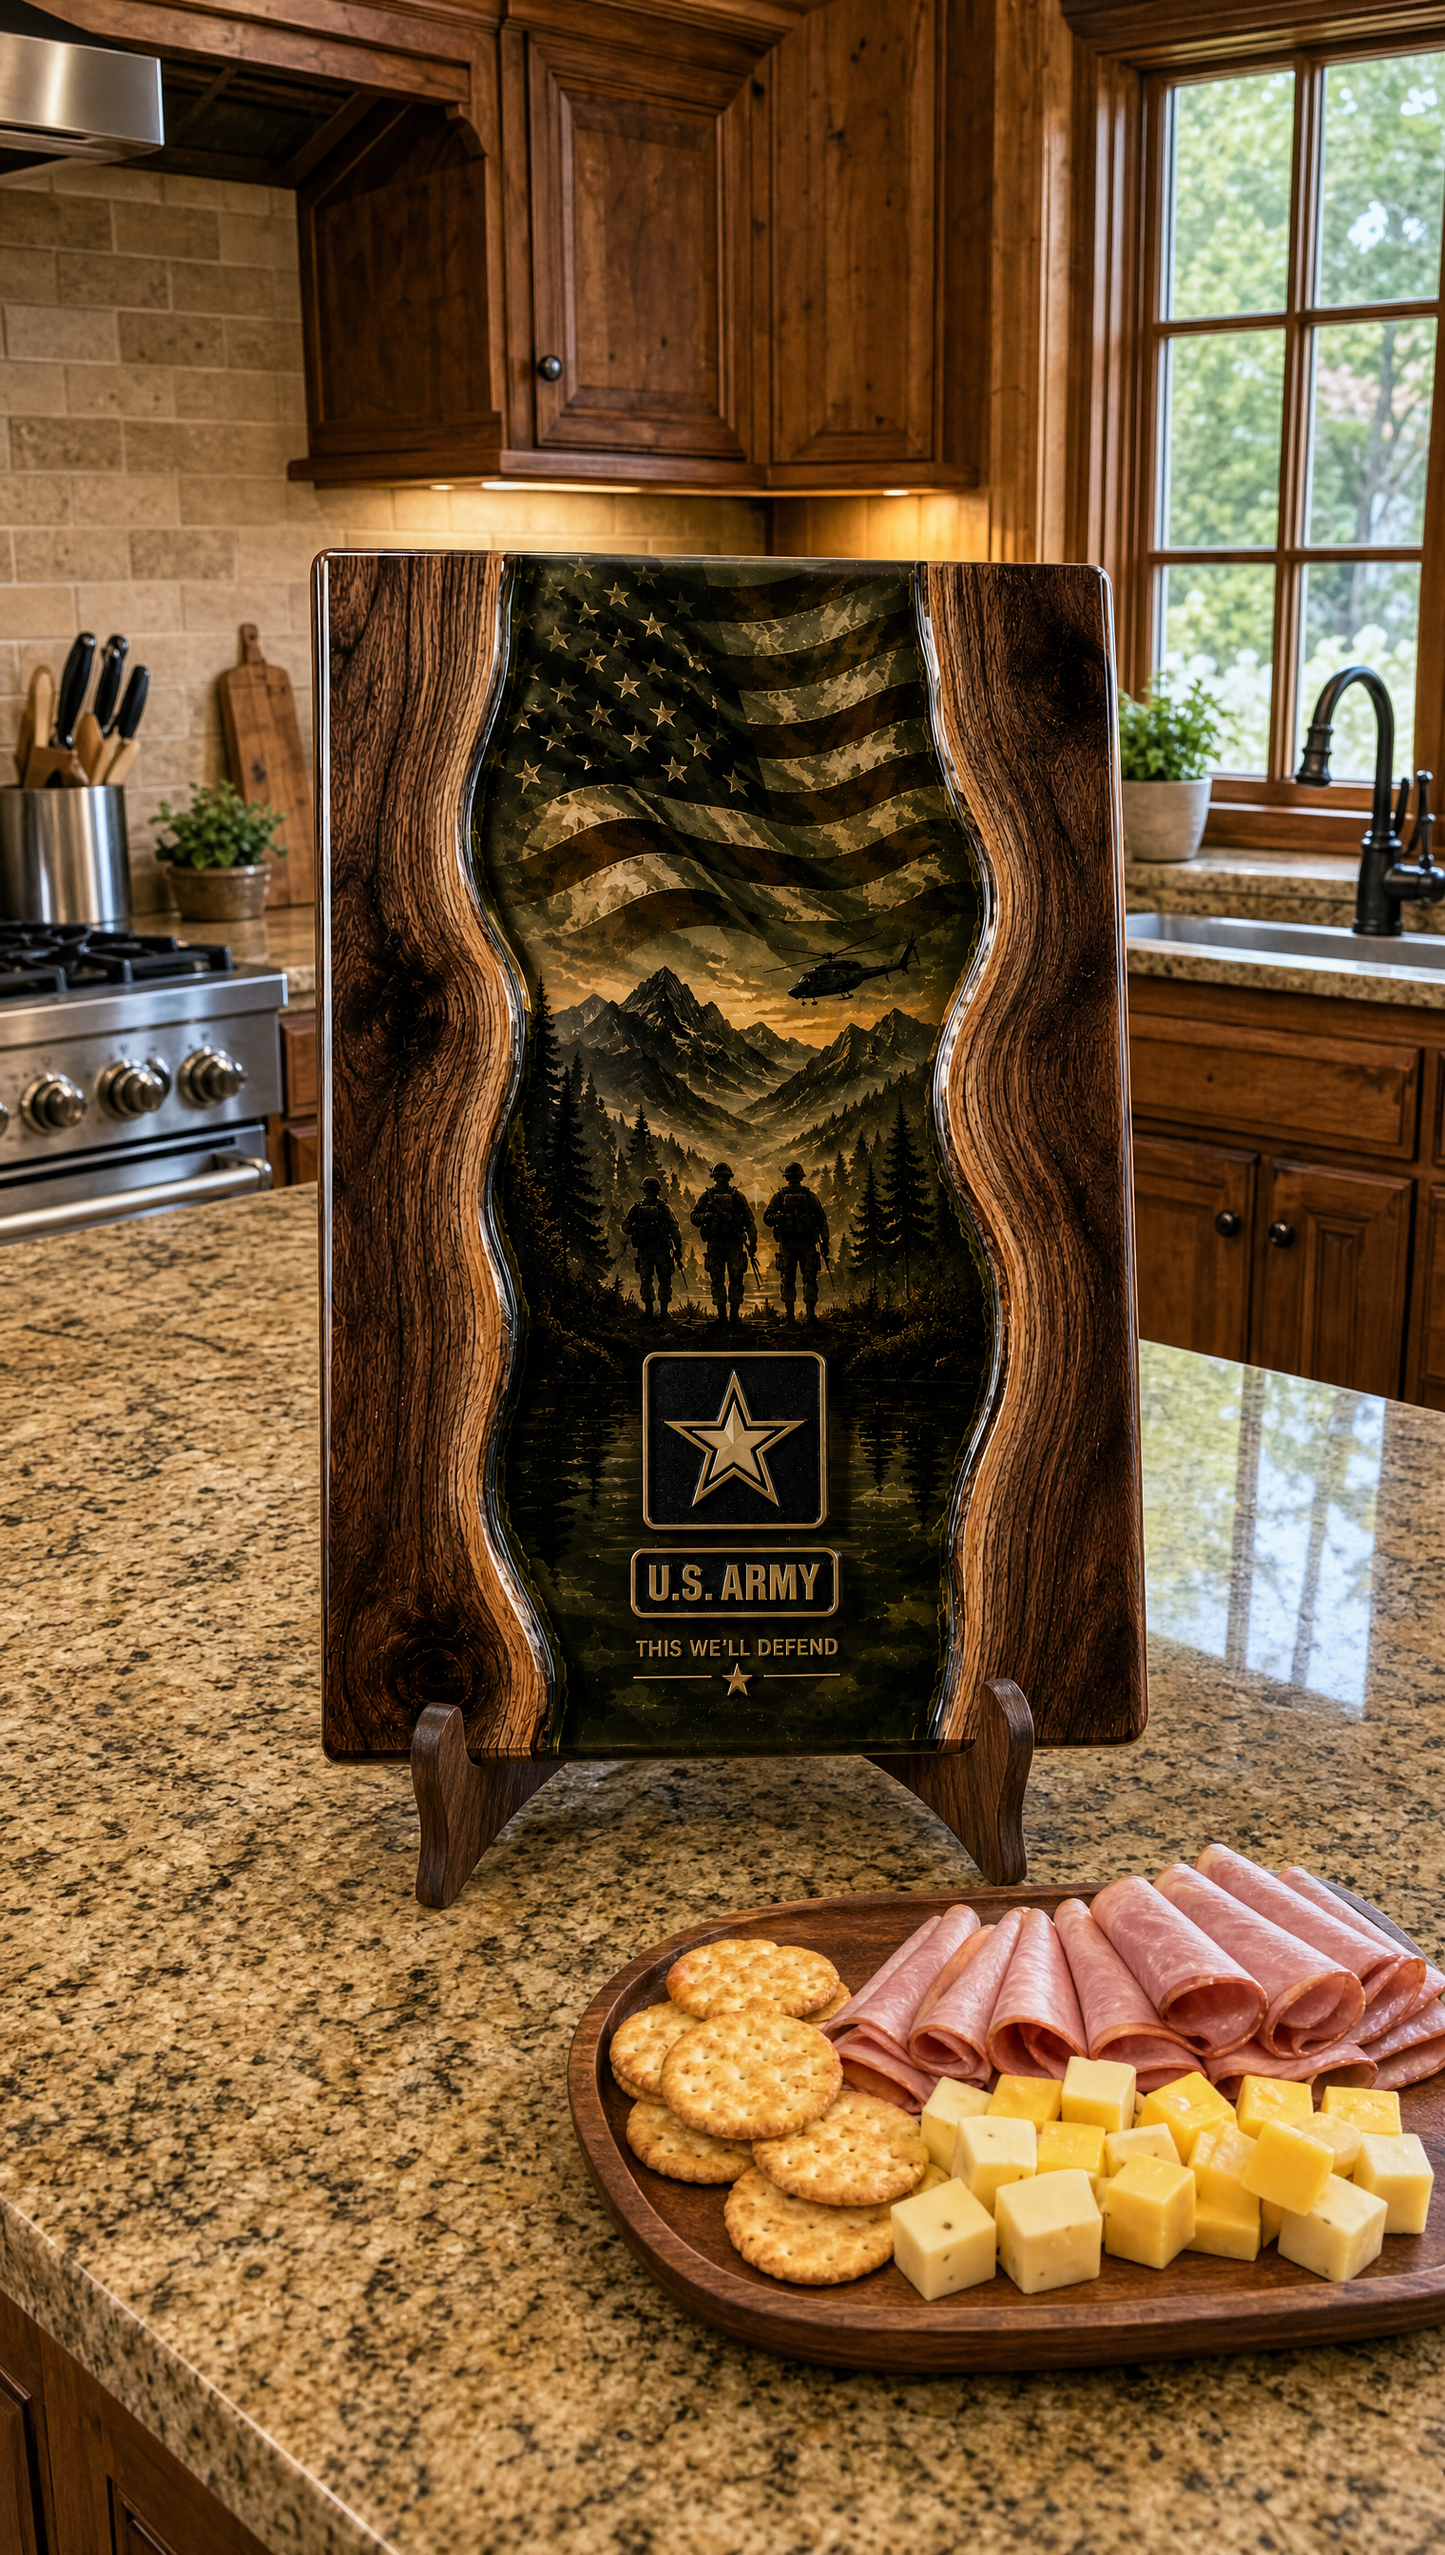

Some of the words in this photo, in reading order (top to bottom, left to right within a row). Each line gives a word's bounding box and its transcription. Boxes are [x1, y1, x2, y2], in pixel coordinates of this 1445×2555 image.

[648, 1564, 713, 1601] U.S.
[720, 1563, 820, 1601] ARMY
[635, 1639, 683, 1657] THIS
[689, 1639, 751, 1657] WE'LL
[757, 1637, 839, 1657] DEFEND
